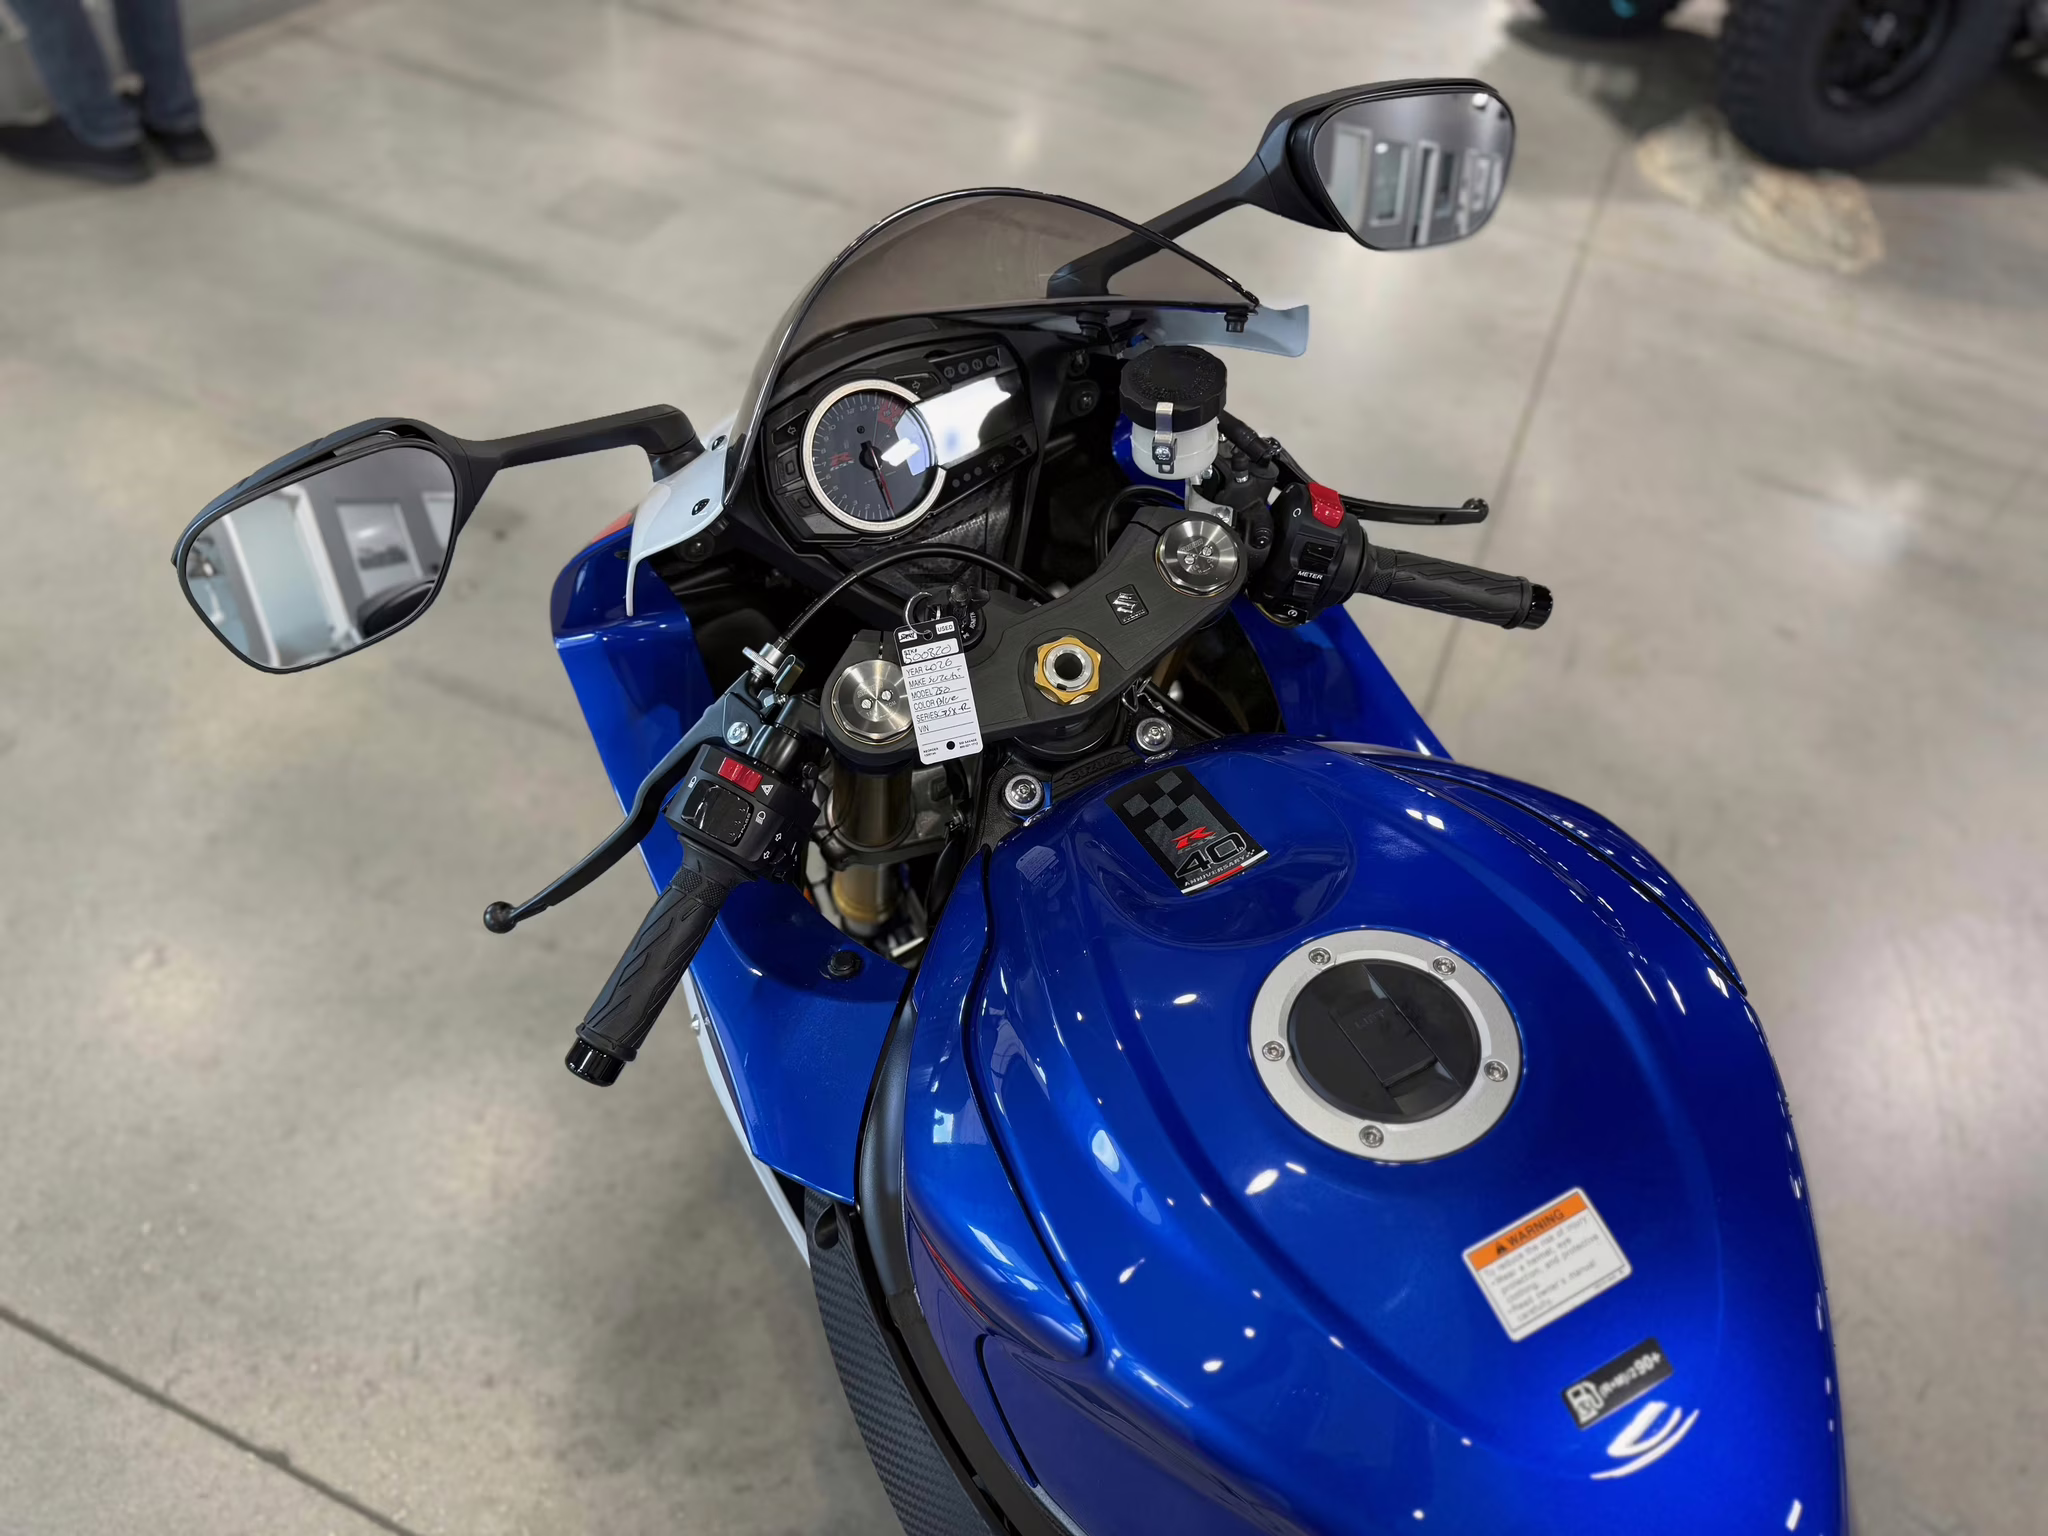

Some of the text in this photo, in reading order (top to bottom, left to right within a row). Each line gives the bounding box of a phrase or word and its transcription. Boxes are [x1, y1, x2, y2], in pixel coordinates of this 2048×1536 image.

[1298, 570, 1323, 580] METER
[937, 624, 953, 632] USED
[906, 667, 923, 676] YEAR
[908, 678, 927, 687] MAKE
[911, 688, 933, 699] MODEL
[913, 699, 935, 710] COLOR
[916, 710, 938, 722] SERIES
[918, 725, 929, 733] VIN
[1184, 855, 1246, 887] ANNIVERSARY
[1505, 1209, 1565, 1247] WARNING
